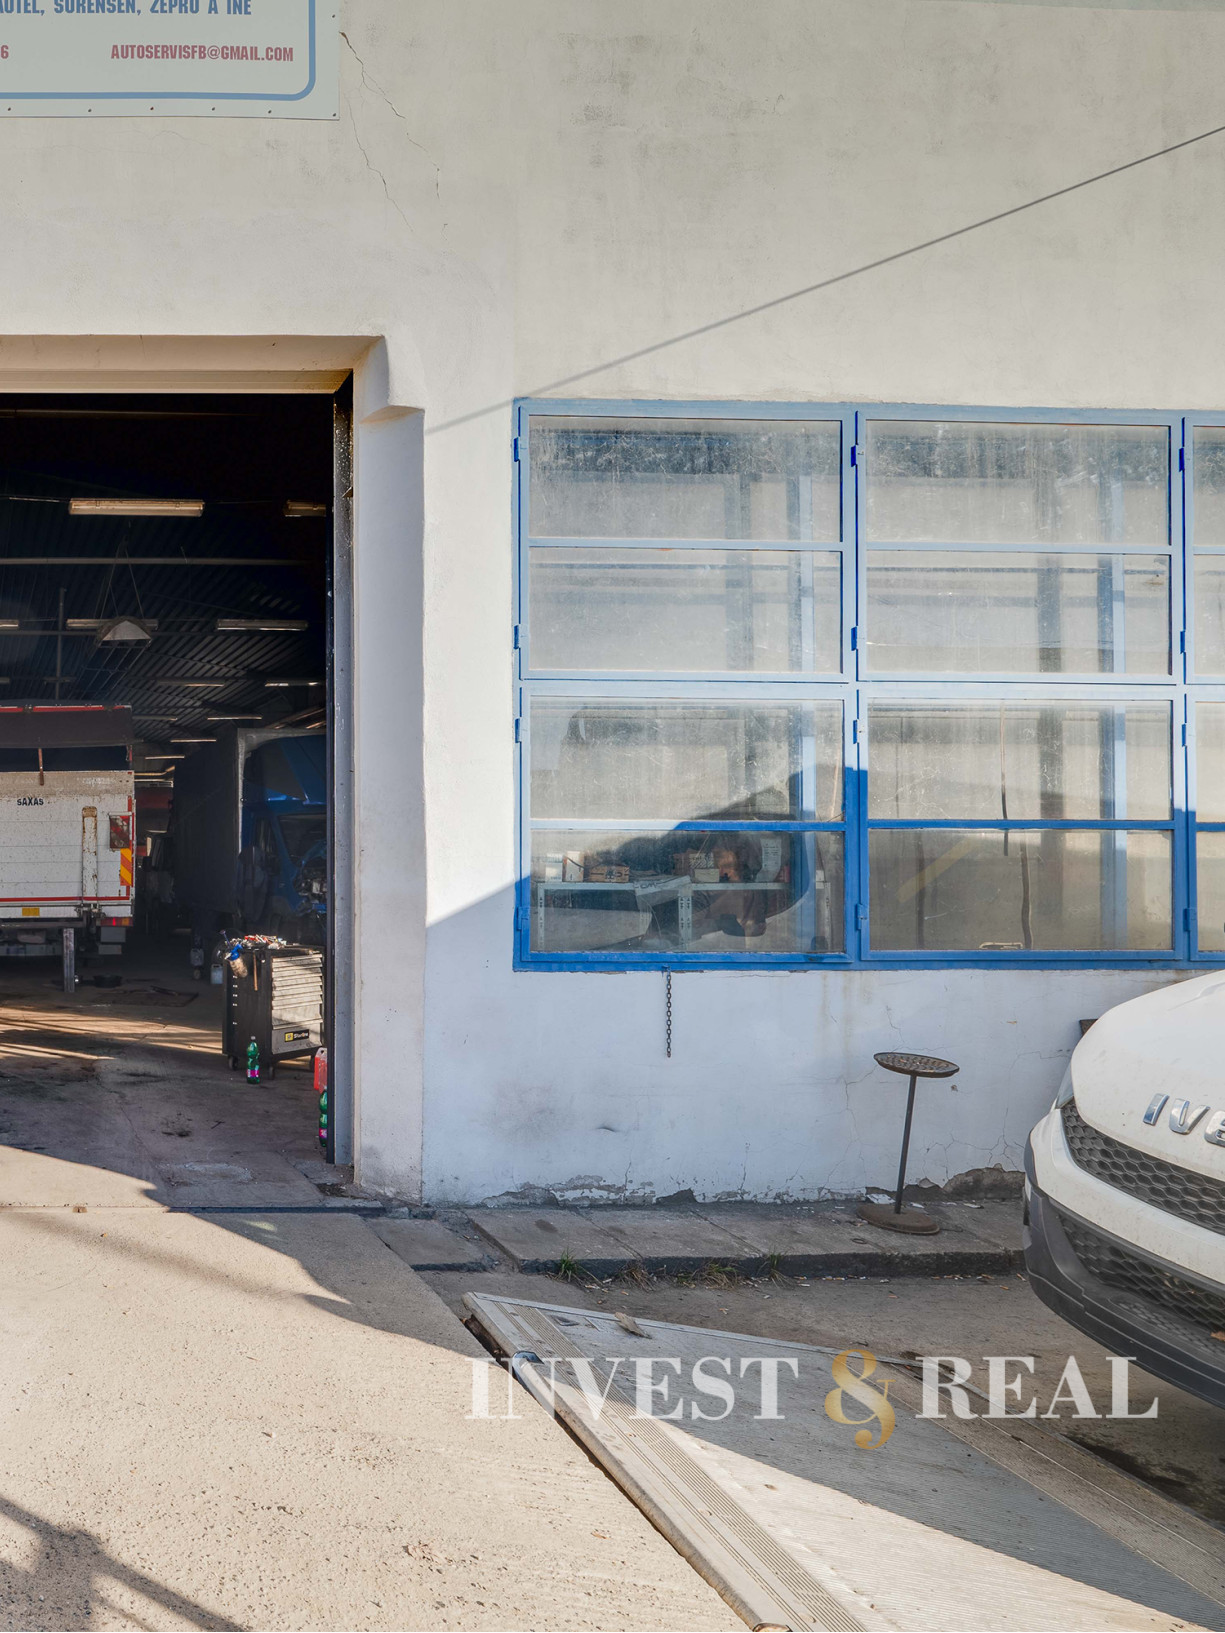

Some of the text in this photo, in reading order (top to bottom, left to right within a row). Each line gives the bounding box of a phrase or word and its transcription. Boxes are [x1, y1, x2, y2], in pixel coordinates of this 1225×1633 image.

[149, 0, 200, 14] ZEPRO
[207, 0, 219, 14] A
[111, 44, 294, 62] AUTOSERVISFB@GMAIL.COM
[16, 797, 44, 806] SAXAS
